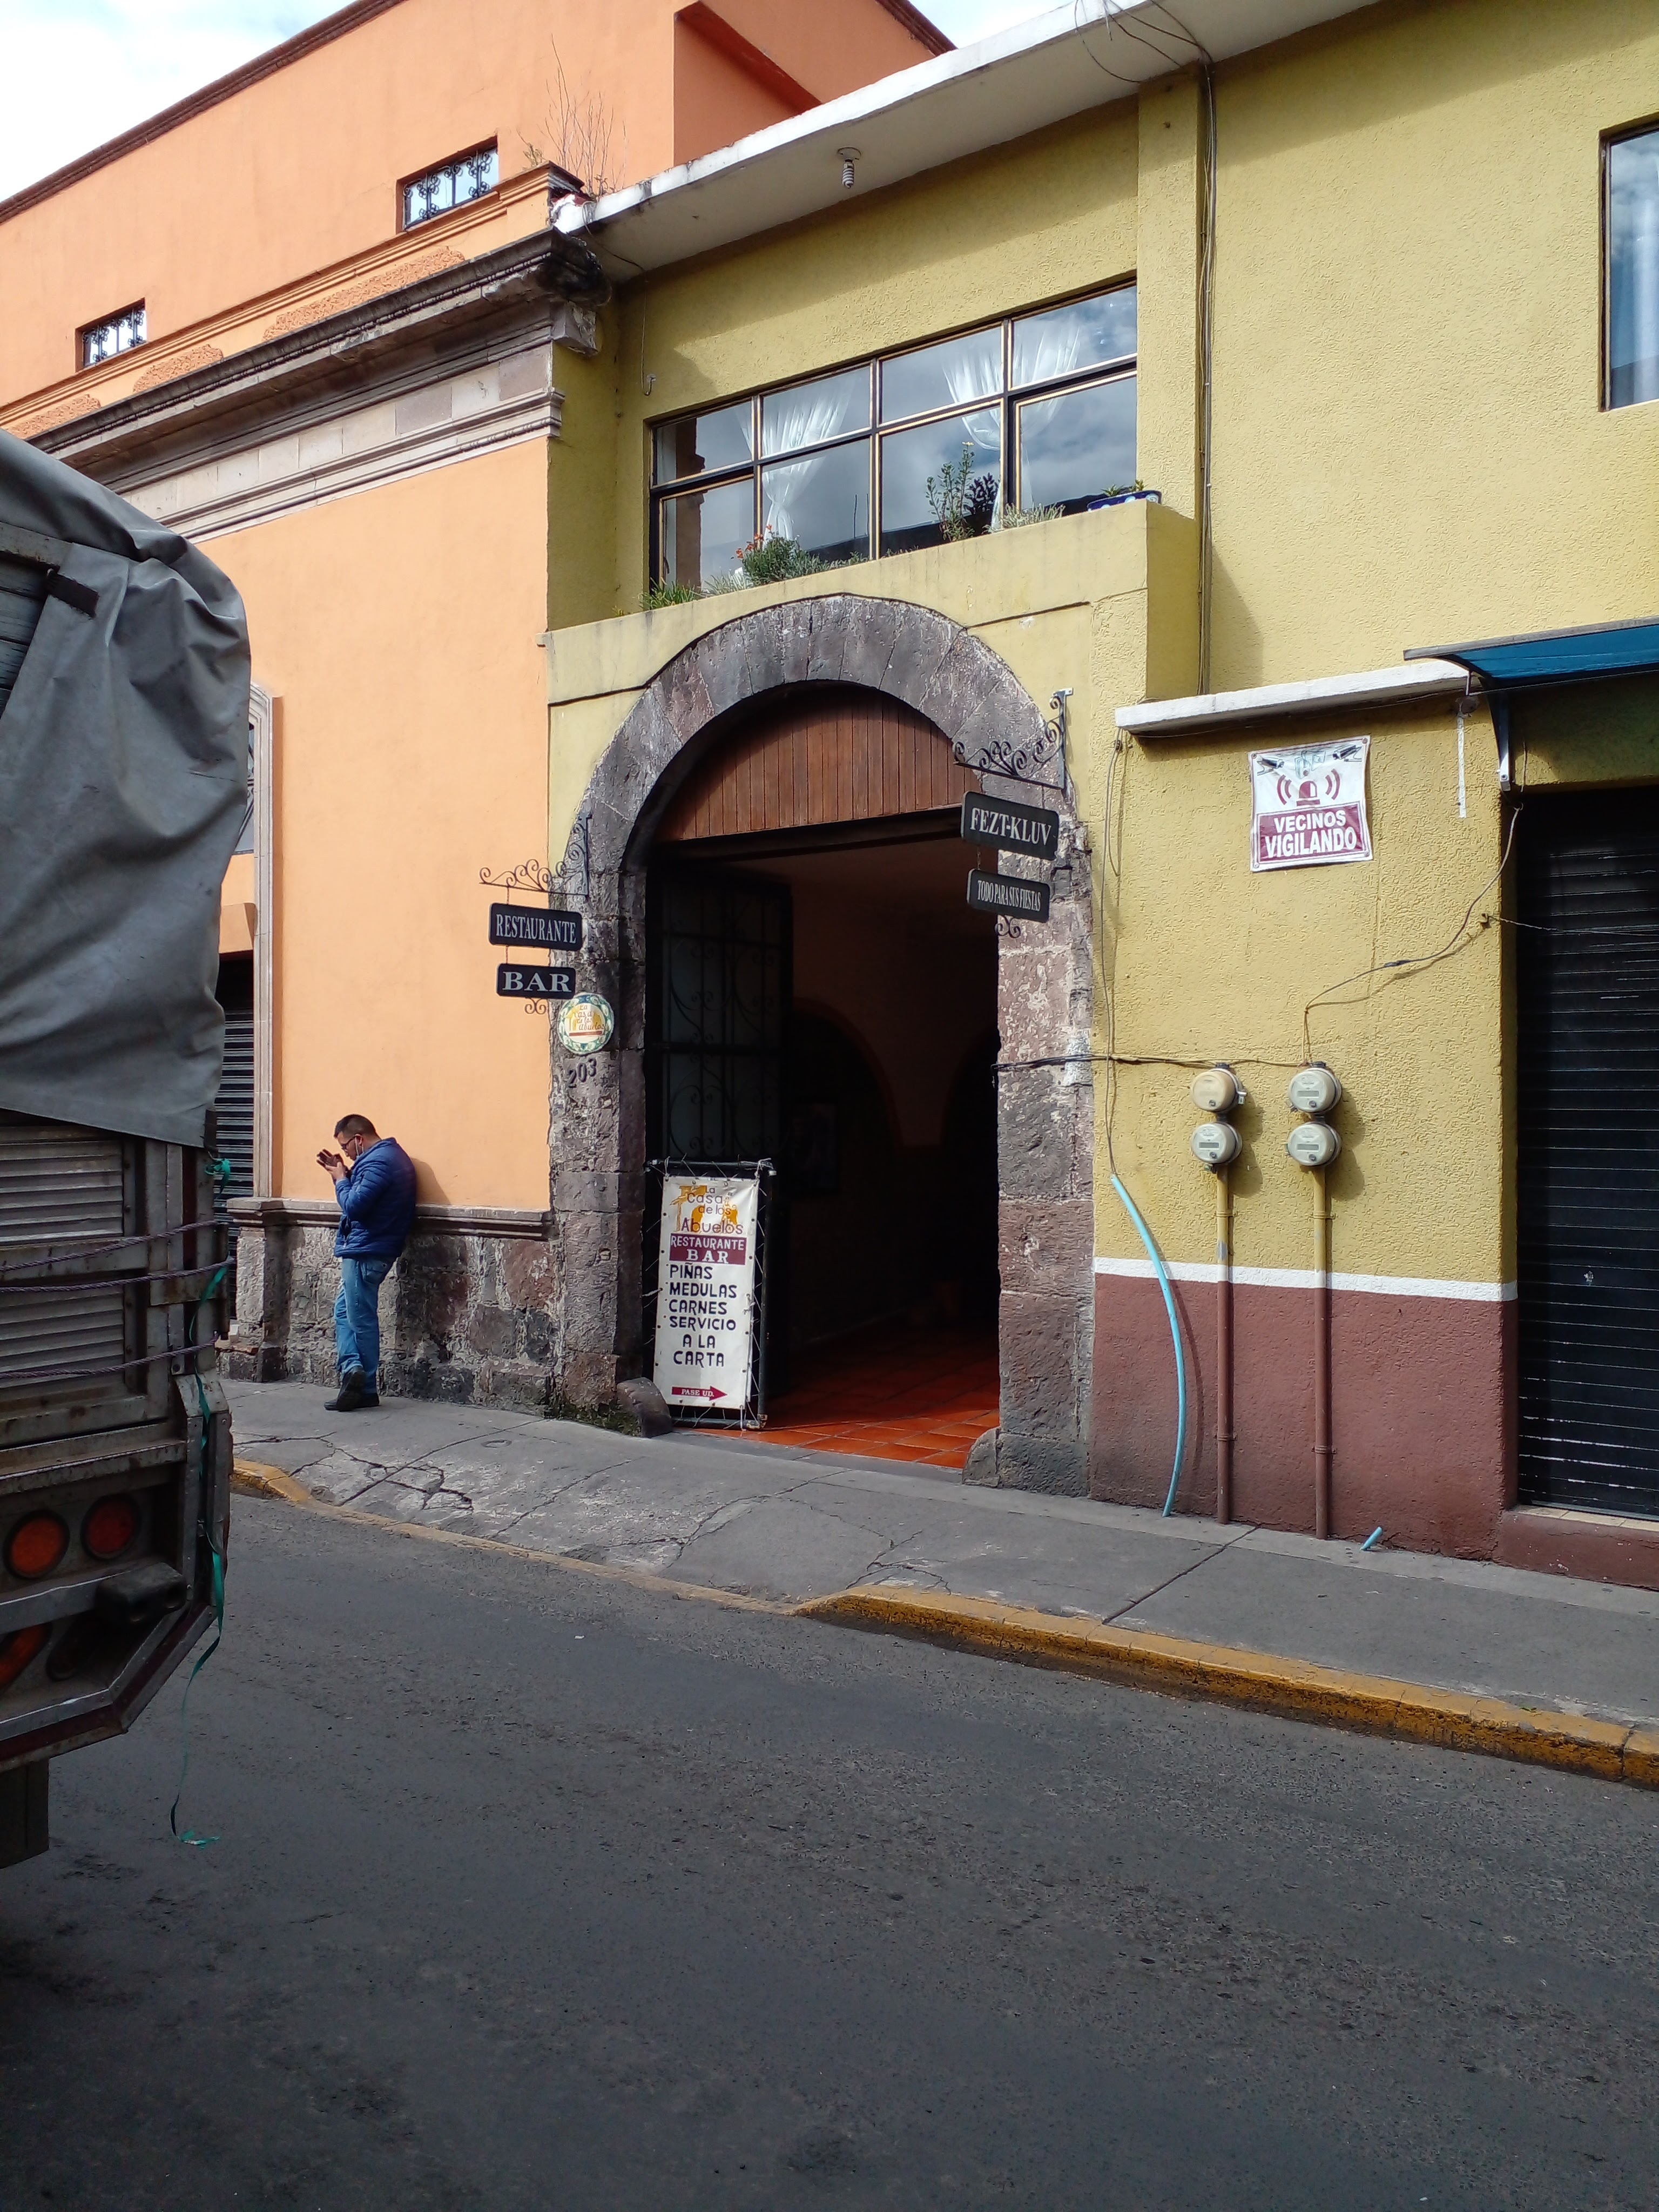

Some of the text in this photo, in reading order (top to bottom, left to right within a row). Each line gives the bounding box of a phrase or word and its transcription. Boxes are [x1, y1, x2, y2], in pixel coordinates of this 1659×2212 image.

[970, 807, 1052, 846] FEZT-KLUV
[1274, 810, 1346, 833] VECINOS
[1265, 827, 1357, 858] VIGILANDO
[977, 880, 1041, 912] TODO PARA SUS FIESTAS
[496, 914, 577, 945] RESTAURANTE
[502, 972, 572, 993] BAR
[567, 1058, 597, 1088] 203
[687, 1192, 723, 1204] Casa
[698, 1204, 731, 1216] de los
[681, 1217, 744, 1235] Abuelos
[671, 1235, 745, 1251] RESTAURANTE
[686, 1249, 729, 1264] BAR
[670, 1262, 713, 1280] PIÑAS
[669, 1282, 738, 1299] MEDULAS
[669, 1299, 727, 1316] CARNES
[669, 1316, 736, 1332] SERVICIO
[683, 1334, 716, 1348] A LA
[673, 1351, 724, 1368] CARTA
